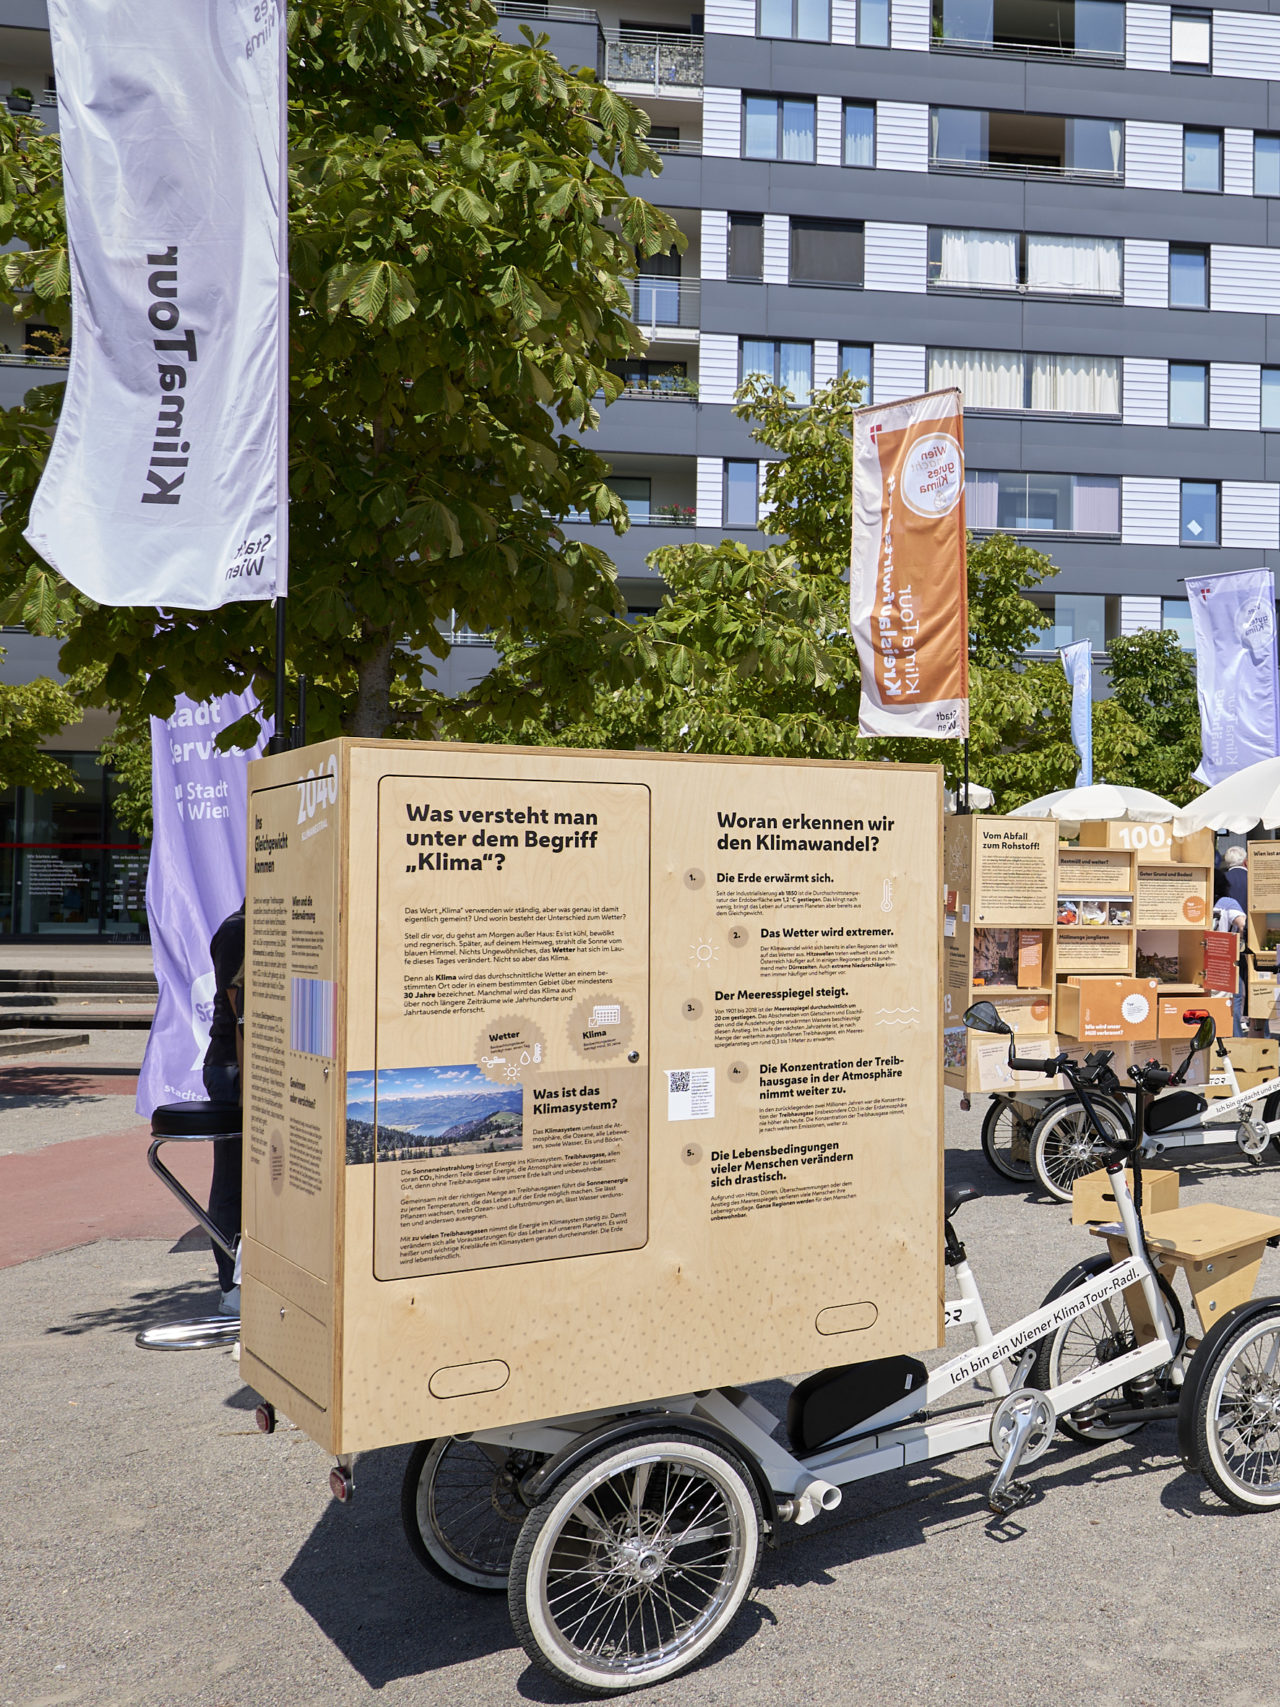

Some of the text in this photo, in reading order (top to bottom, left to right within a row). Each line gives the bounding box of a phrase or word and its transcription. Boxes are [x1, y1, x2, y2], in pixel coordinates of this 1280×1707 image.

[187, 780, 228, 800] Stadt
[297, 754, 339, 825] 2040
[188, 802, 230, 821] Wien
[405, 803, 598, 825] Was versteht man
[255, 814, 263, 830] Ins
[716, 812, 895, 831] Woran erkennen wir
[254, 832, 288, 855] Gleichgewicht
[406, 828, 598, 852] unter dem Begriff
[716, 833, 879, 852] den Klimawandel?
[1003, 832, 1028, 840] Abfall
[1001, 842, 1040, 850] Rohstoff!
[254, 858, 275, 874] kommen
[405, 851, 506, 873] „Klima“?
[716, 872, 834, 883] Die Erde erwärmt sich.
[404, 906, 418, 914] Das
[418, 906, 438, 914] Wort
[438, 906, 463, 915] „Klima“
[464, 906, 502, 914] verwenden
[514, 906, 541, 915] ständig,
[571, 907, 591, 915] genau
[760, 926, 894, 938] Das Wetter wird extremer.
[714, 986, 848, 1001] Der Meeresspiegel steigt.
[488, 1031, 520, 1042] Wetter
[582, 1030, 607, 1040] Klima
[759, 1055, 904, 1074] Die Konzentration der Treib-
[759, 1068, 902, 1087] hausgase in der Atmosphäre
[532, 1085, 600, 1099] Was ist das
[759, 1085, 846, 1100] nimmt weiter zu.
[1226, 1101, 1236, 1109] bin
[1237, 1090, 1260, 1106] gedacht
[1260, 1085, 1273, 1095] und
[533, 1099, 617, 1115] Klimasystem?
[711, 1142, 839, 1161] Die Lebensbedingungen
[710, 1151, 853, 1174] vieler Menschen verändern
[710, 1170, 787, 1188] sich drastisch.
[950, 1267, 1140, 1385] Ich bin ein Wiener KlimaTour-Radl.
